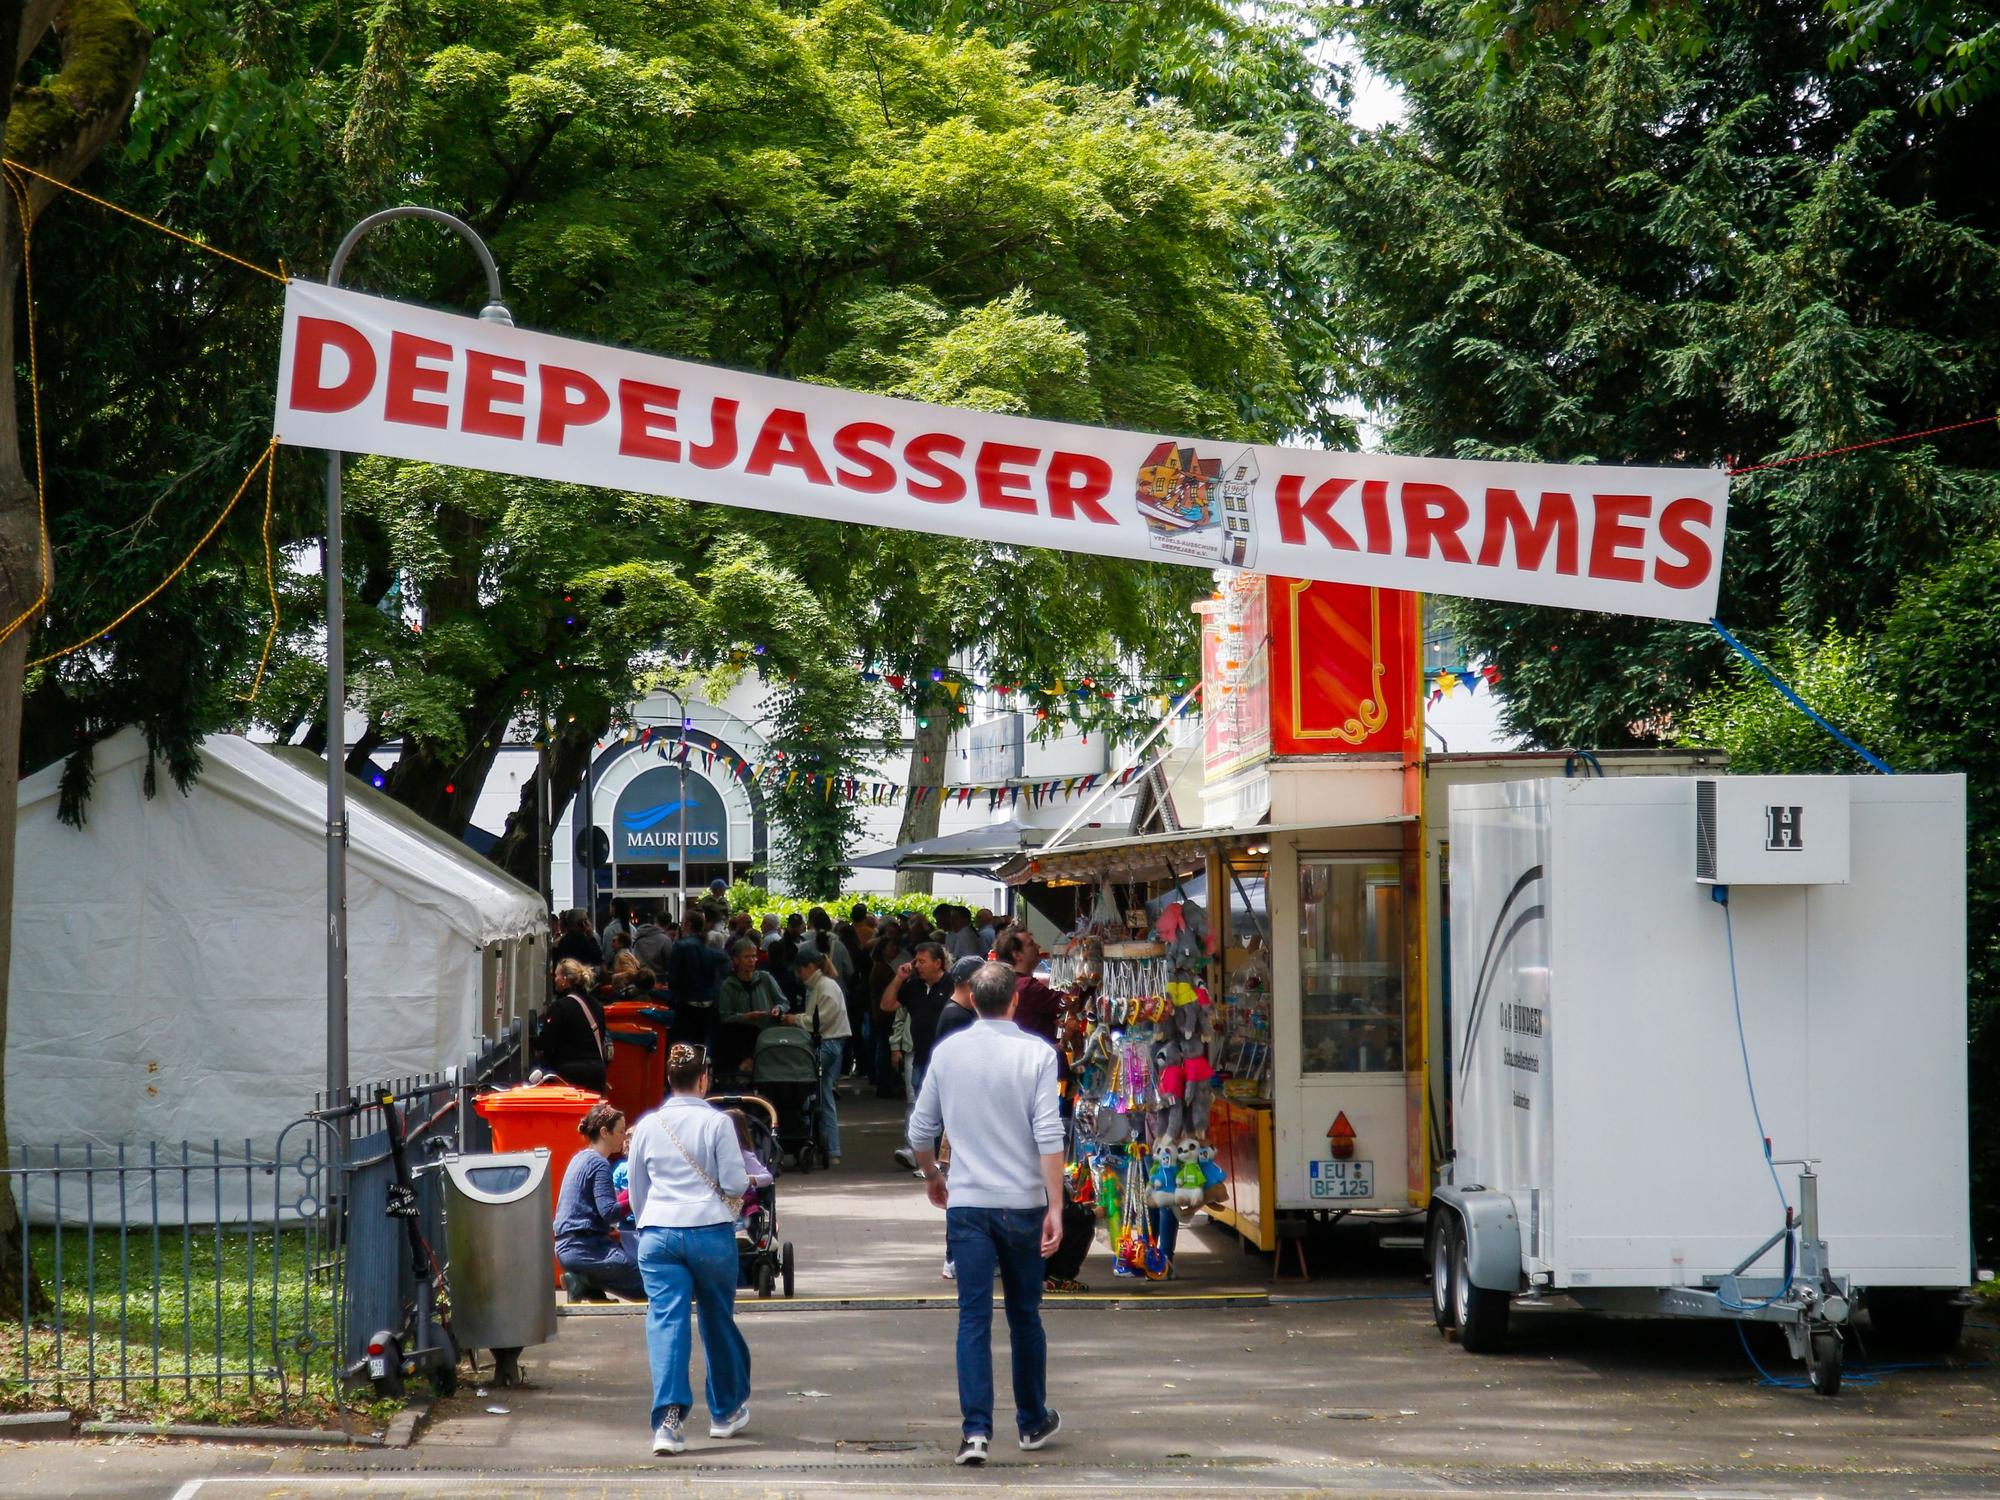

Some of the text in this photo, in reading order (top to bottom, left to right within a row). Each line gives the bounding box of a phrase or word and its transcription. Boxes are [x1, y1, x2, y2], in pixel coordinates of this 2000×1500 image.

[290, 315, 1713, 589] DEEPEJASSER KIRMES
[1766, 805, 1804, 851] H
[627, 832, 719, 847] MAURITIUS
[1325, 1163, 1346, 1179] EU
[1314, 1180, 1369, 1196] BF 125
